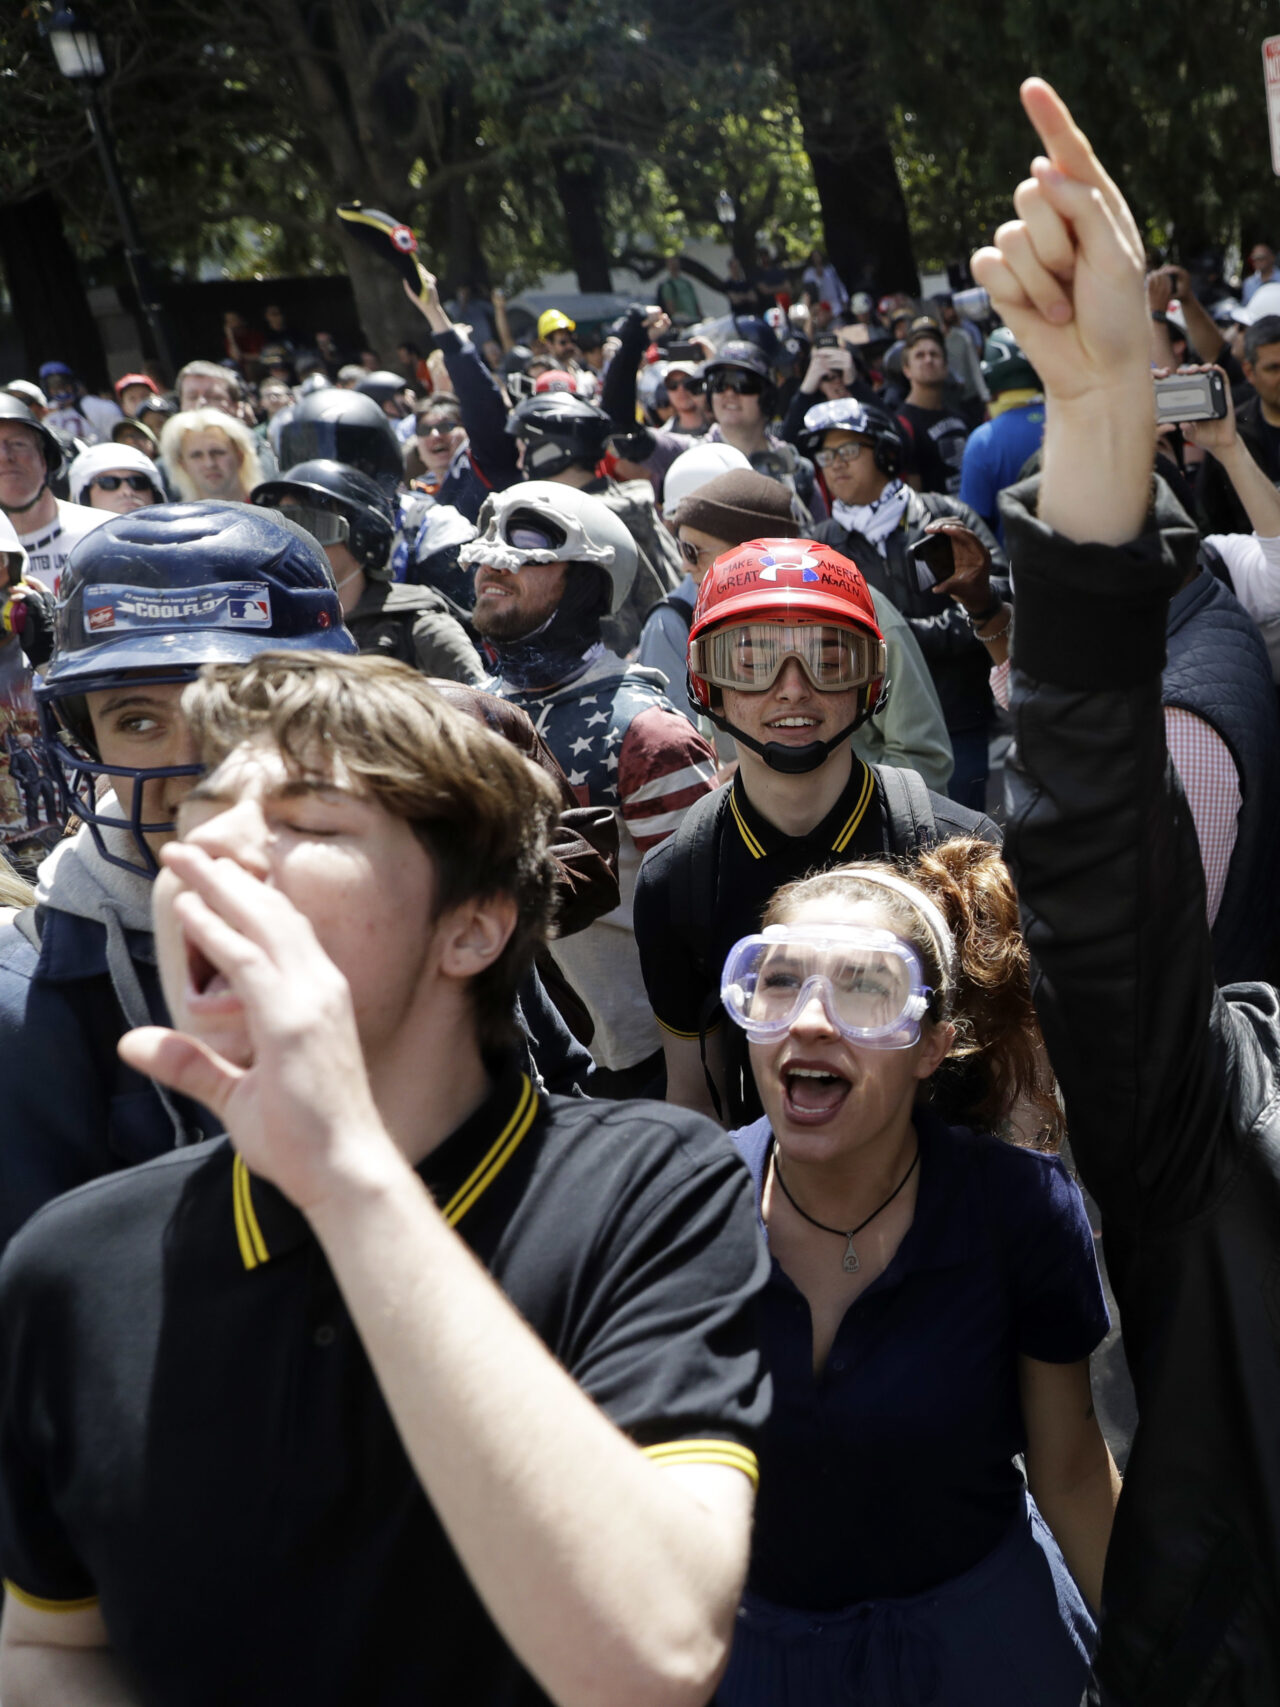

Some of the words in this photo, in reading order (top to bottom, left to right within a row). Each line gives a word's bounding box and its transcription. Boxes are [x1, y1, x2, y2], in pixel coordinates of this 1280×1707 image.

[723, 558, 753, 575] MAKE
[716, 570, 759, 594] GREAT
[821, 573, 860, 597] AGAIN
[135, 601, 217, 618] COOLFLO
